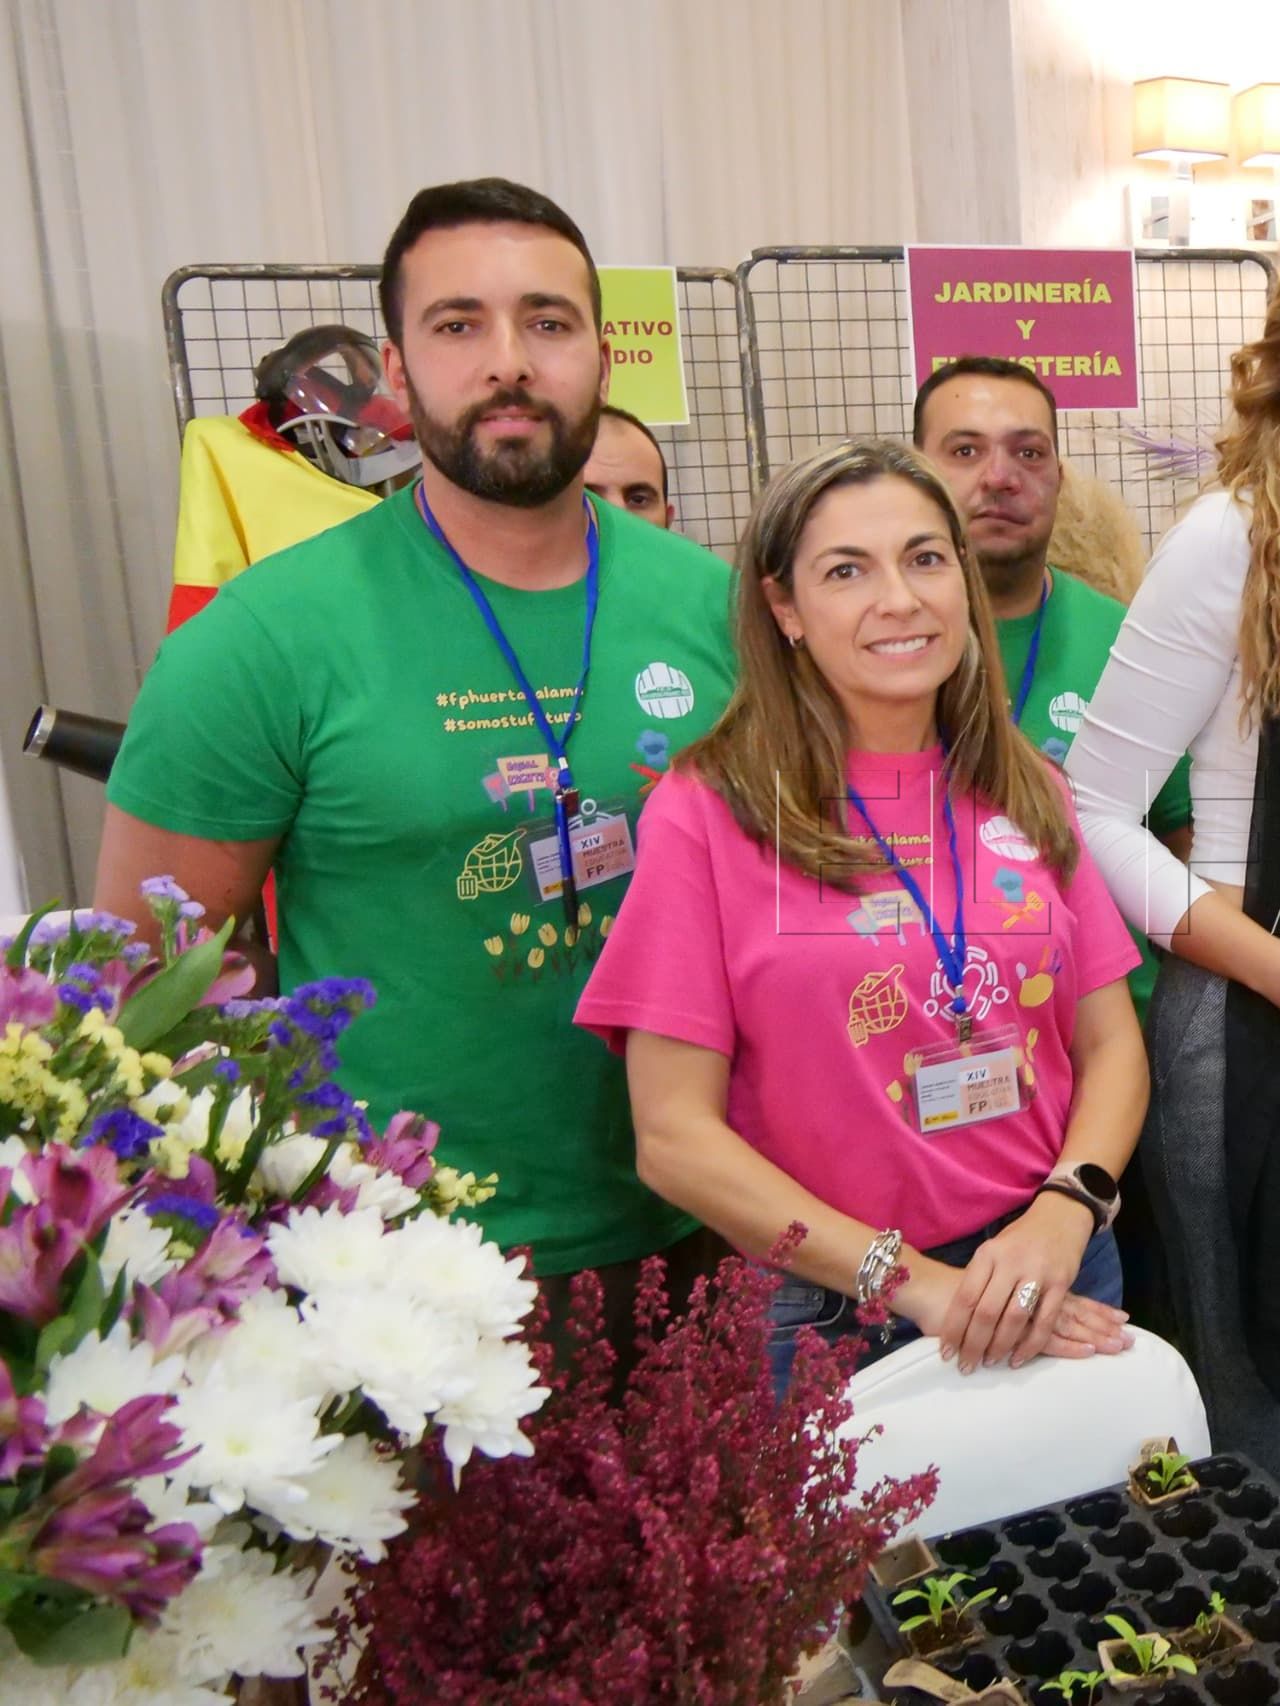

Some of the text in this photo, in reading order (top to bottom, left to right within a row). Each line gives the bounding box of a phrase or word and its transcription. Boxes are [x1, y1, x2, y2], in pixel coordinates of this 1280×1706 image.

[934, 278, 1112, 304] JARDINERÍA
[1016, 319, 1036, 341] Y
[931, 351, 1122, 377] FSTERÍA
[580, 835, 601, 849] XIV
[586, 864, 605, 879] FP
[969, 1100, 987, 1114] FP
